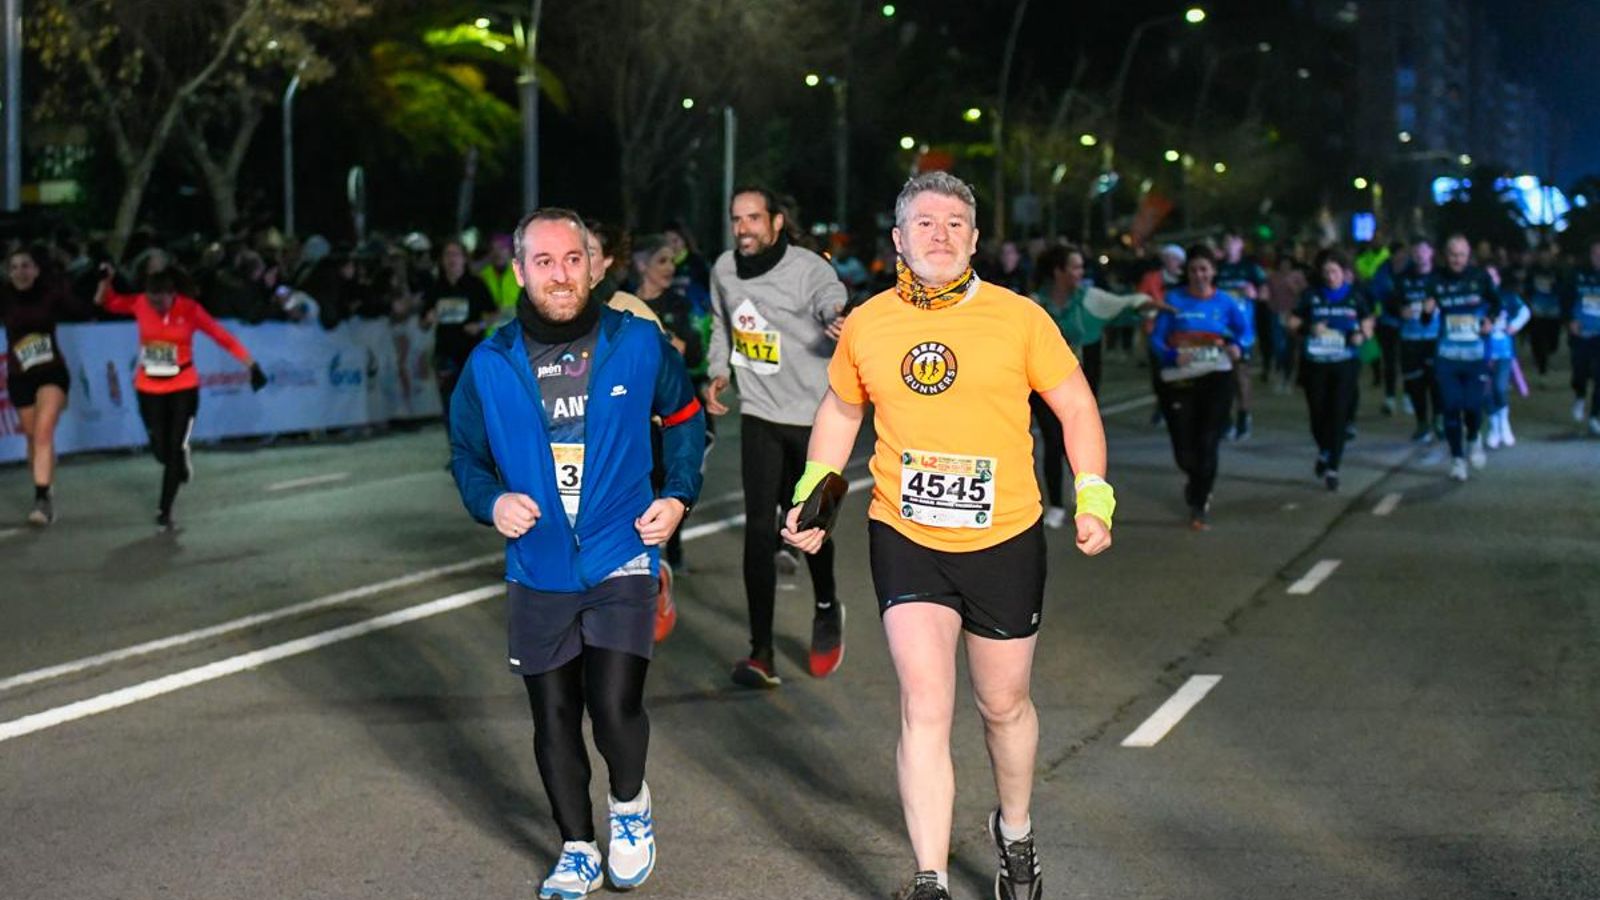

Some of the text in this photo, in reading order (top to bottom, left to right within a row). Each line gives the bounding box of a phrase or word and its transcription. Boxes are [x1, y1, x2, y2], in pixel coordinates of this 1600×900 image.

[738, 315, 756, 330] 95
[911, 343, 946, 357] BEER
[537, 363, 562, 378] jaén
[904, 369, 956, 394] RUNNERS
[553, 395, 589, 419] AN
[920, 455, 938, 469] 42
[561, 465, 579, 487] 3
[907, 471, 986, 502] 4545
